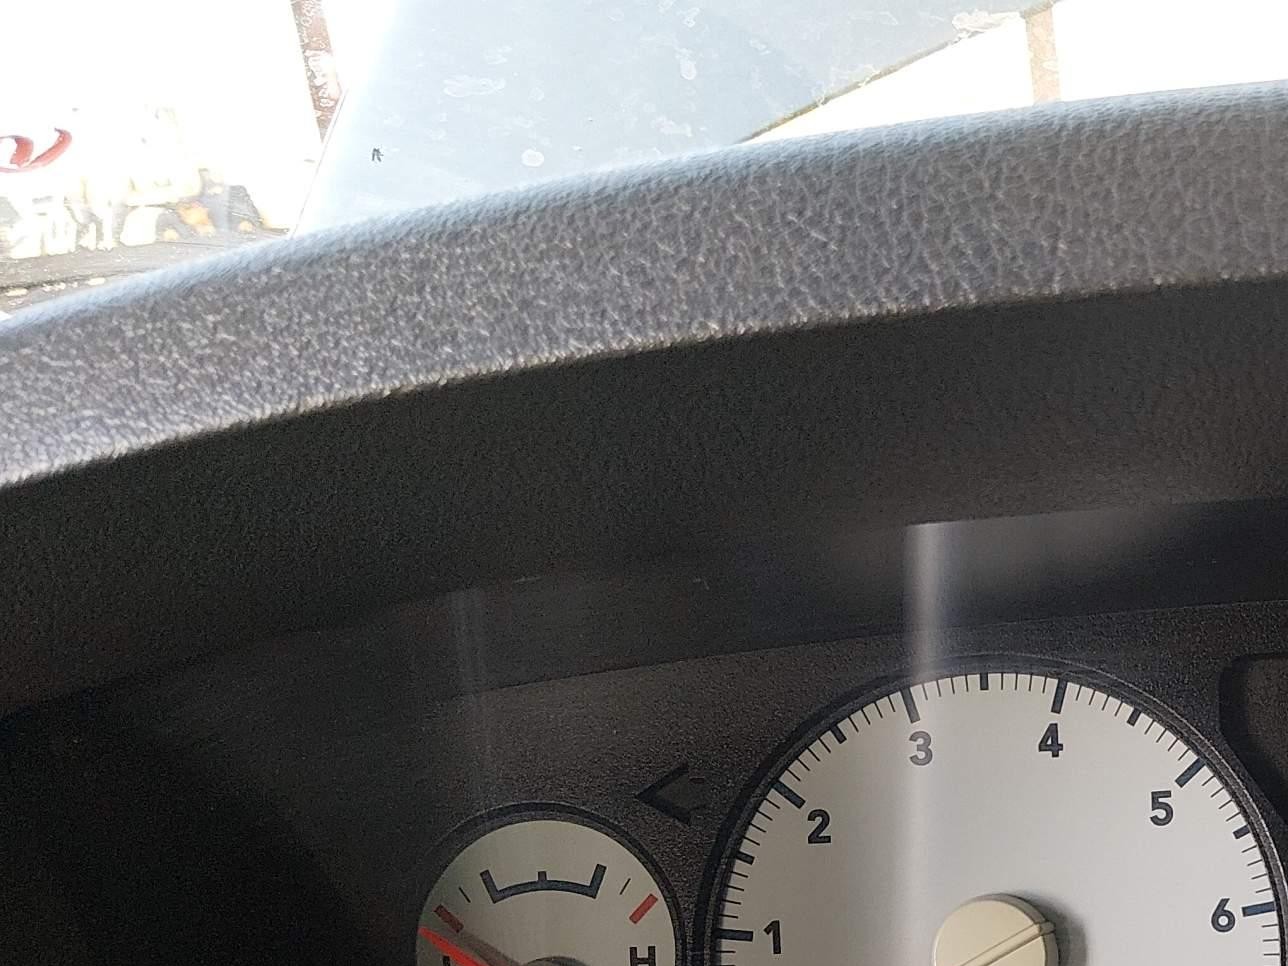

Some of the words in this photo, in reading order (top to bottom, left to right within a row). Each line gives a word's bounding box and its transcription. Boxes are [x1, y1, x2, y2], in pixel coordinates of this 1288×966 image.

[909, 731, 933, 766] 3
[1038, 723, 1064, 758] 4
[1149, 789, 1173, 826] 5
[806, 808, 832, 844] 2
[1210, 897, 1236, 933] 6
[762, 920, 783, 955] 1
